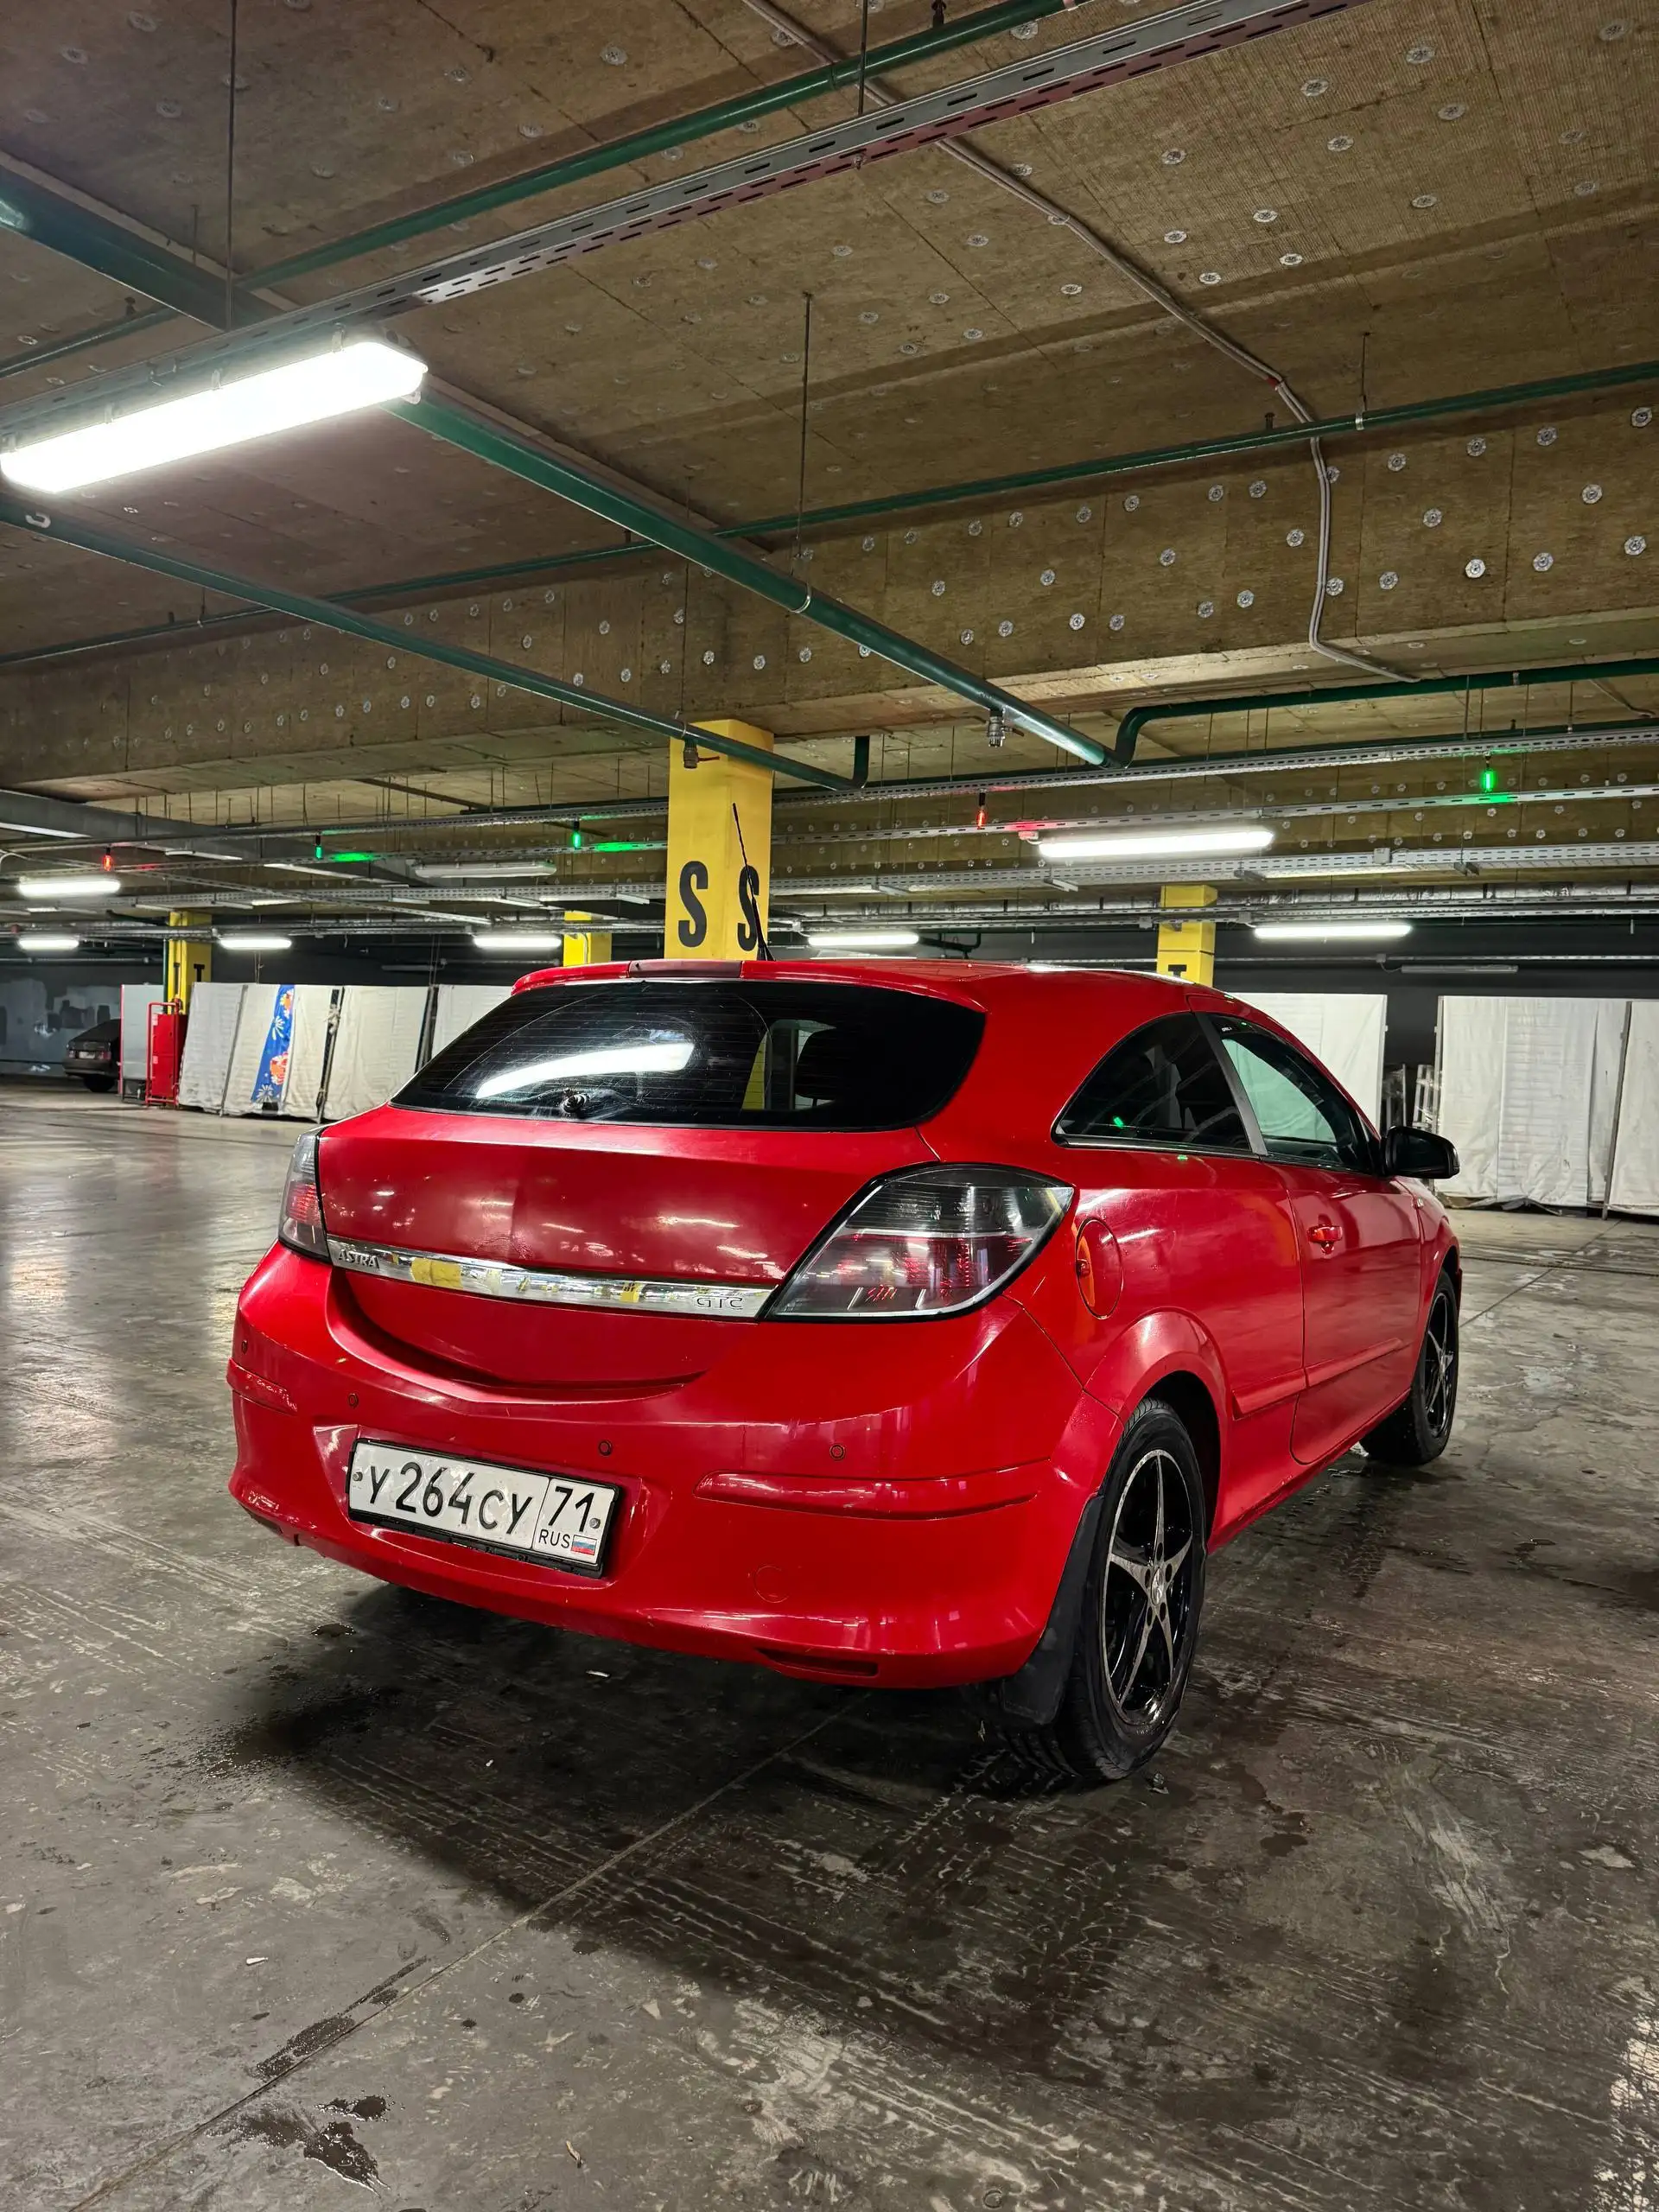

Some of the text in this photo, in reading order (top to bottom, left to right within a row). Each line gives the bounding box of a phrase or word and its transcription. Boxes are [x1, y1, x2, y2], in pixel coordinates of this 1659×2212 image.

[677, 860, 709, 948] S
[737, 864, 760, 951] S
[338, 1249, 379, 1269] ASTRA
[696, 1296, 743, 1309] GTC
[548, 1486, 594, 1532] 71
[538, 1529, 570, 1549] RUS
